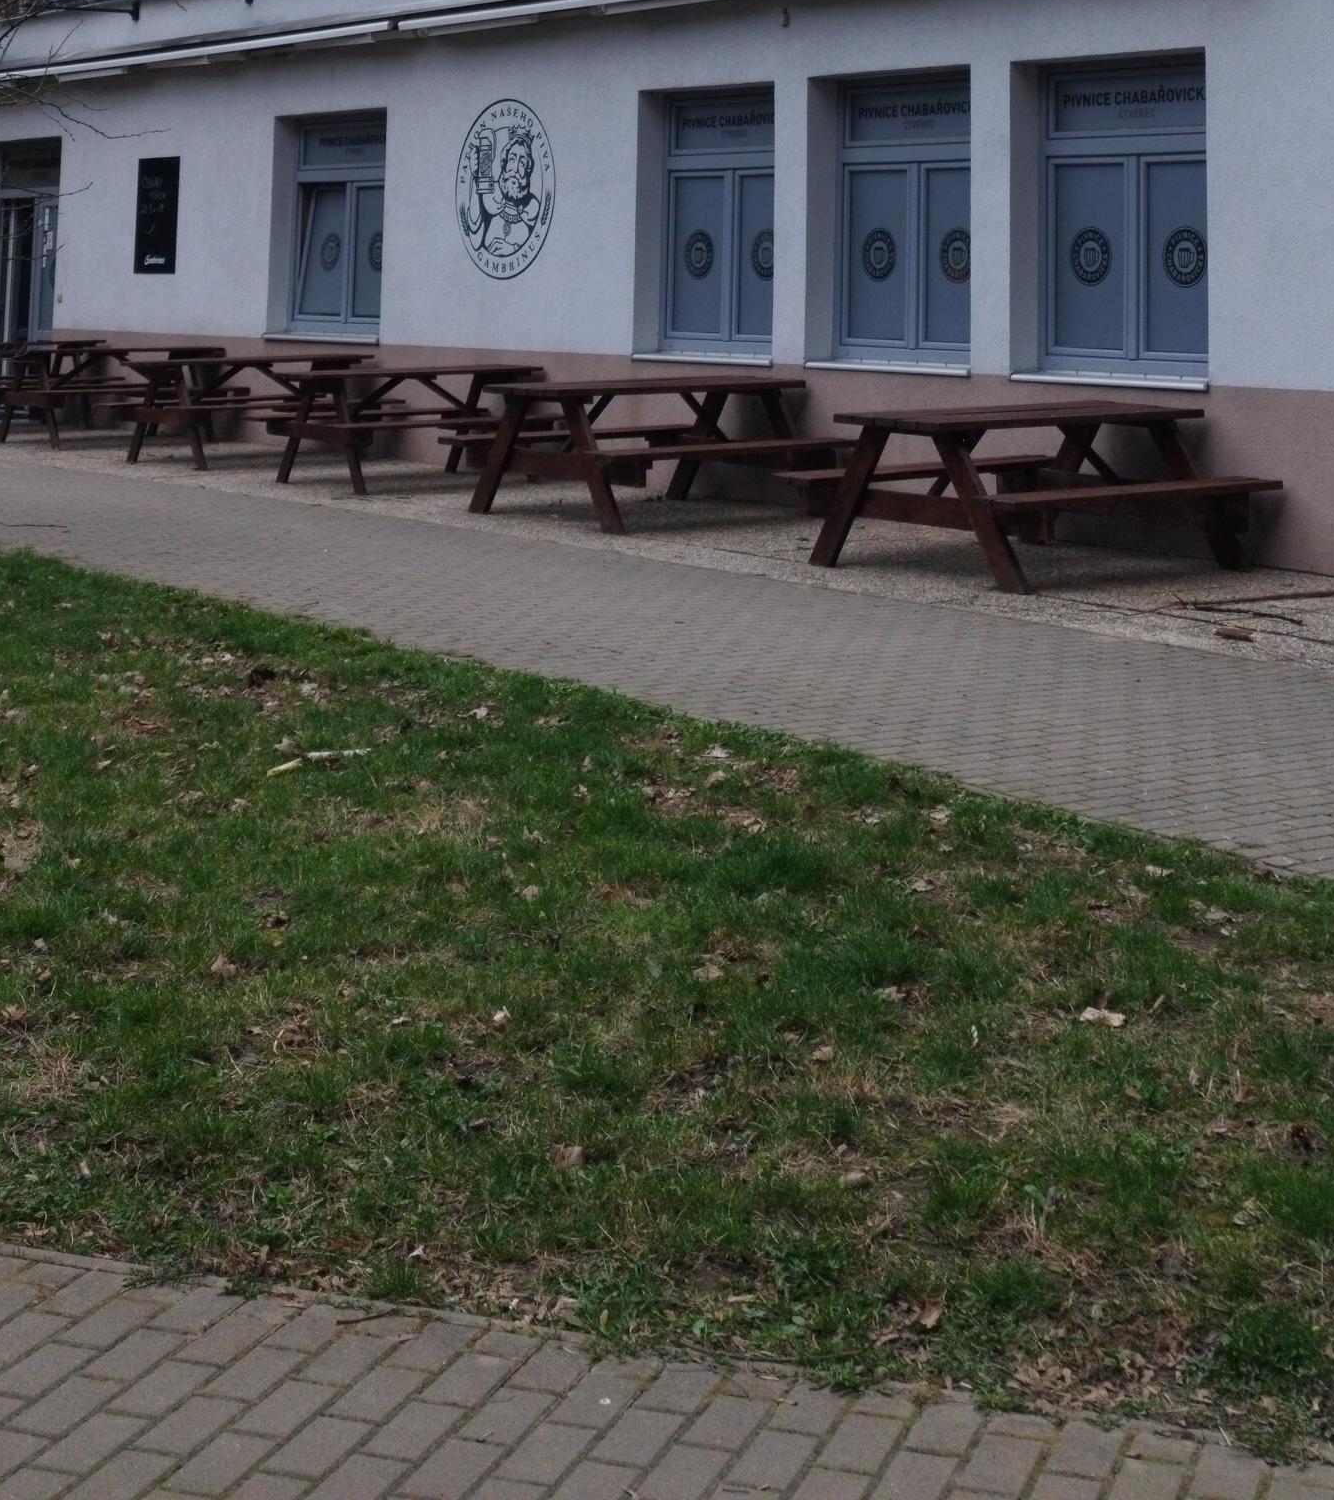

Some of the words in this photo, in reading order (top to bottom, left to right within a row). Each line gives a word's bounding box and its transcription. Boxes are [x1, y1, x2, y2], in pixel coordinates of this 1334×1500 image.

[1063, 92, 1112, 109] PIVNICE
[1114, 85, 1207, 106] CHABAŘOVICK
[859, 104, 899, 120] PIVNICE
[476, 231, 542, 274] GAMBRINUS
